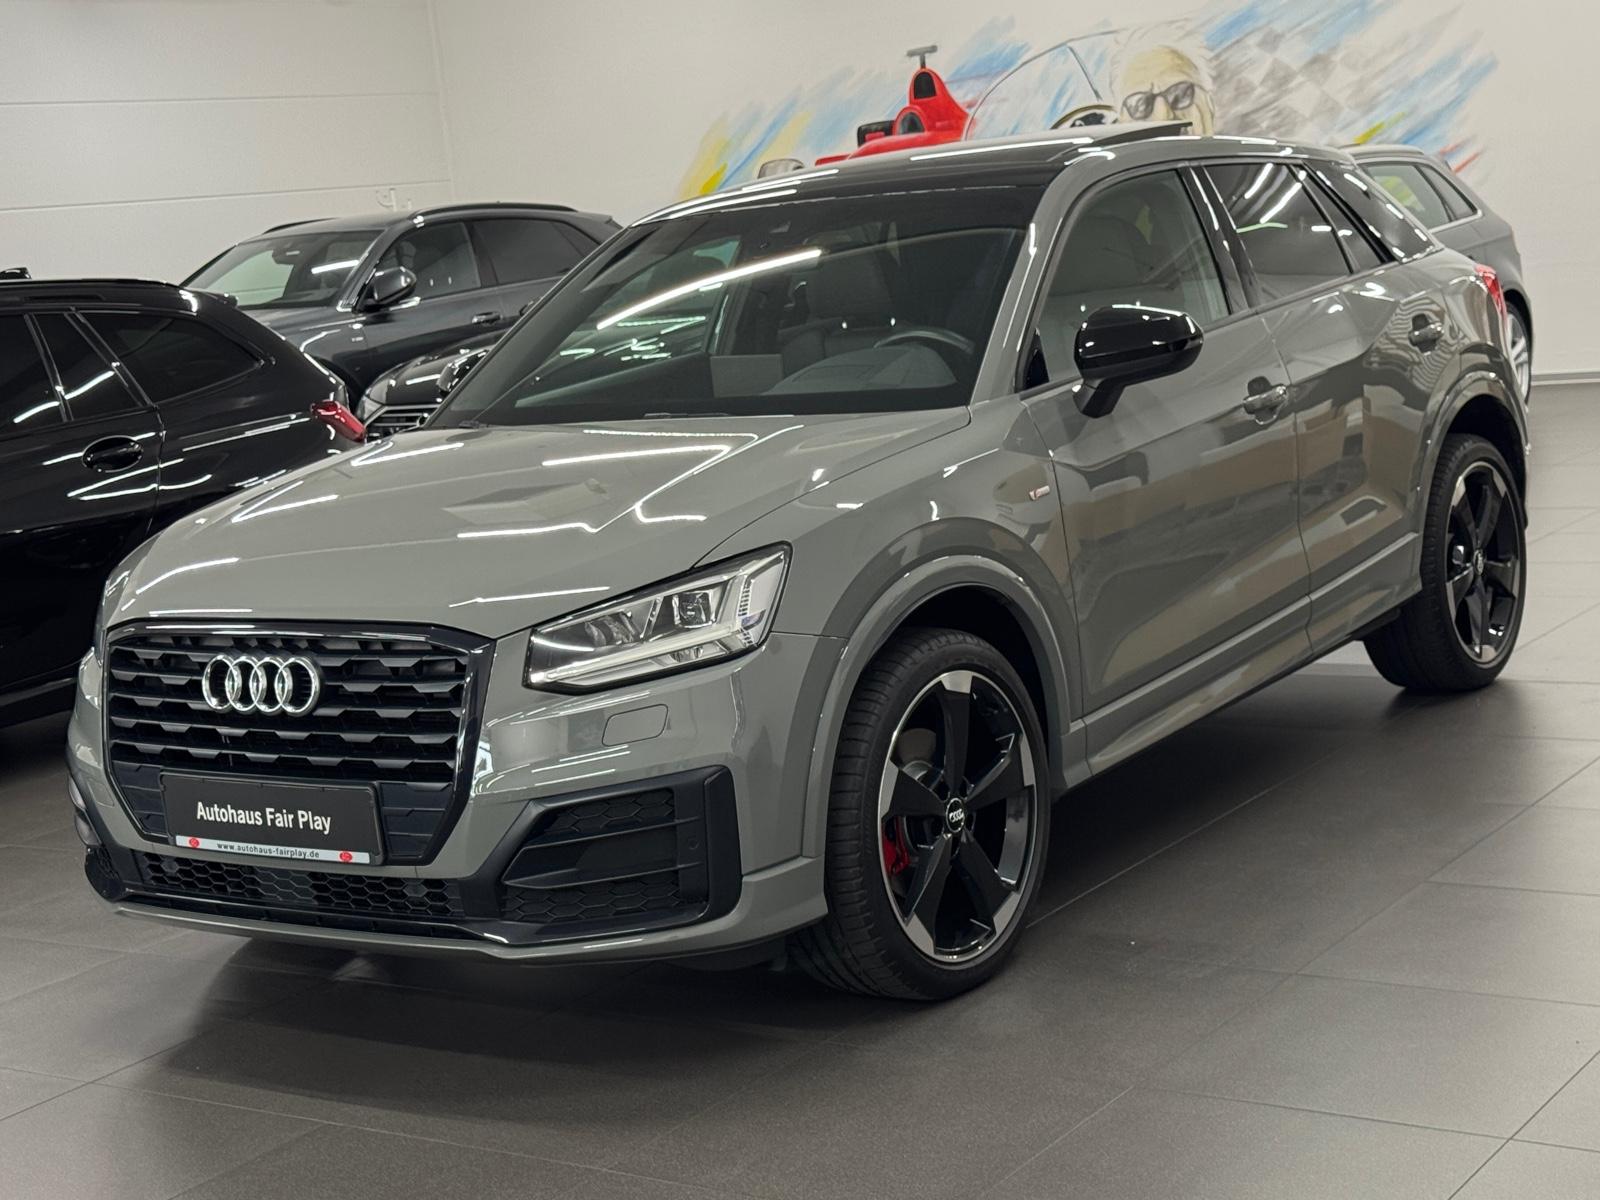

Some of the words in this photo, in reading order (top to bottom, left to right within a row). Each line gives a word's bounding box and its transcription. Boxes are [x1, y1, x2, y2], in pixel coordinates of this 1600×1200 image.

[197, 801, 263, 826] Autohaus
[266, 807, 294, 829] Fair
[298, 809, 332, 835] Play
[217, 842, 320, 858] www.autohaus-fairplay.de
